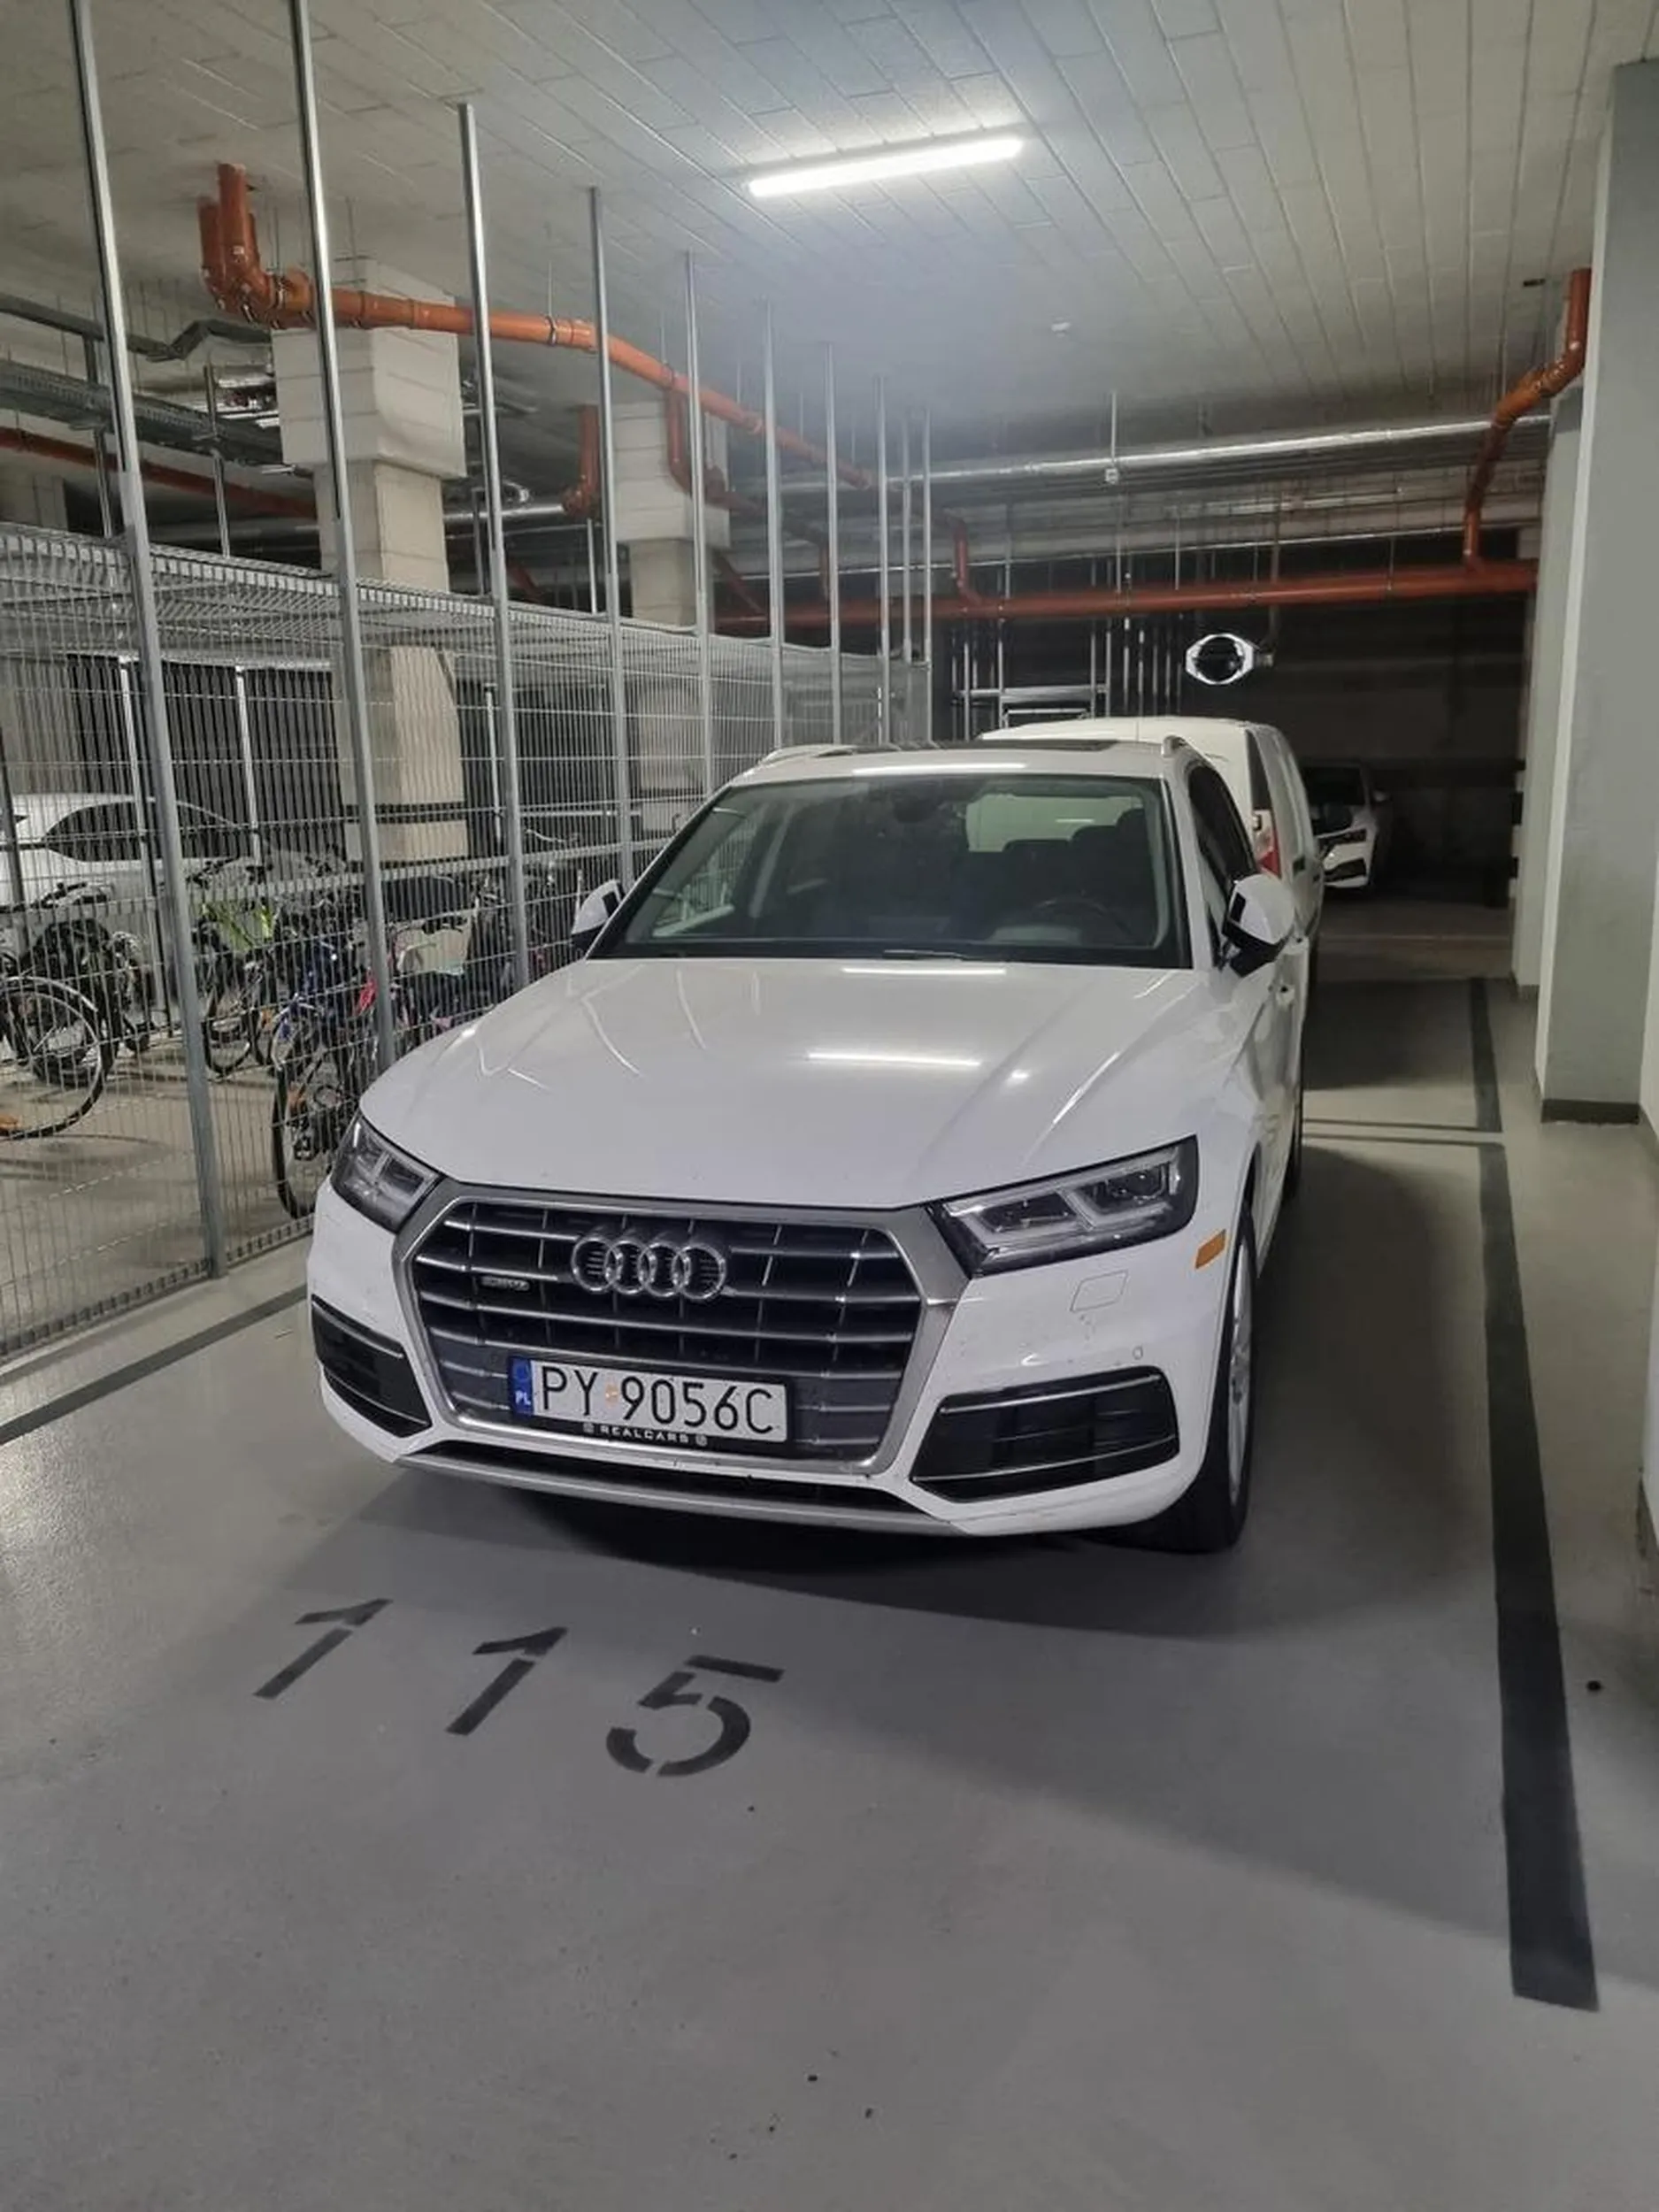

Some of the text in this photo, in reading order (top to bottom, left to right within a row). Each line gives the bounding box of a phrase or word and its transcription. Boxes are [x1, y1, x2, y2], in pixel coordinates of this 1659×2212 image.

[515, 1391, 531, 1405] PL
[541, 1365, 773, 1433] PY 9056C
[600, 1425, 689, 1443] REALCARS
[251, 1598, 785, 1777] 115
